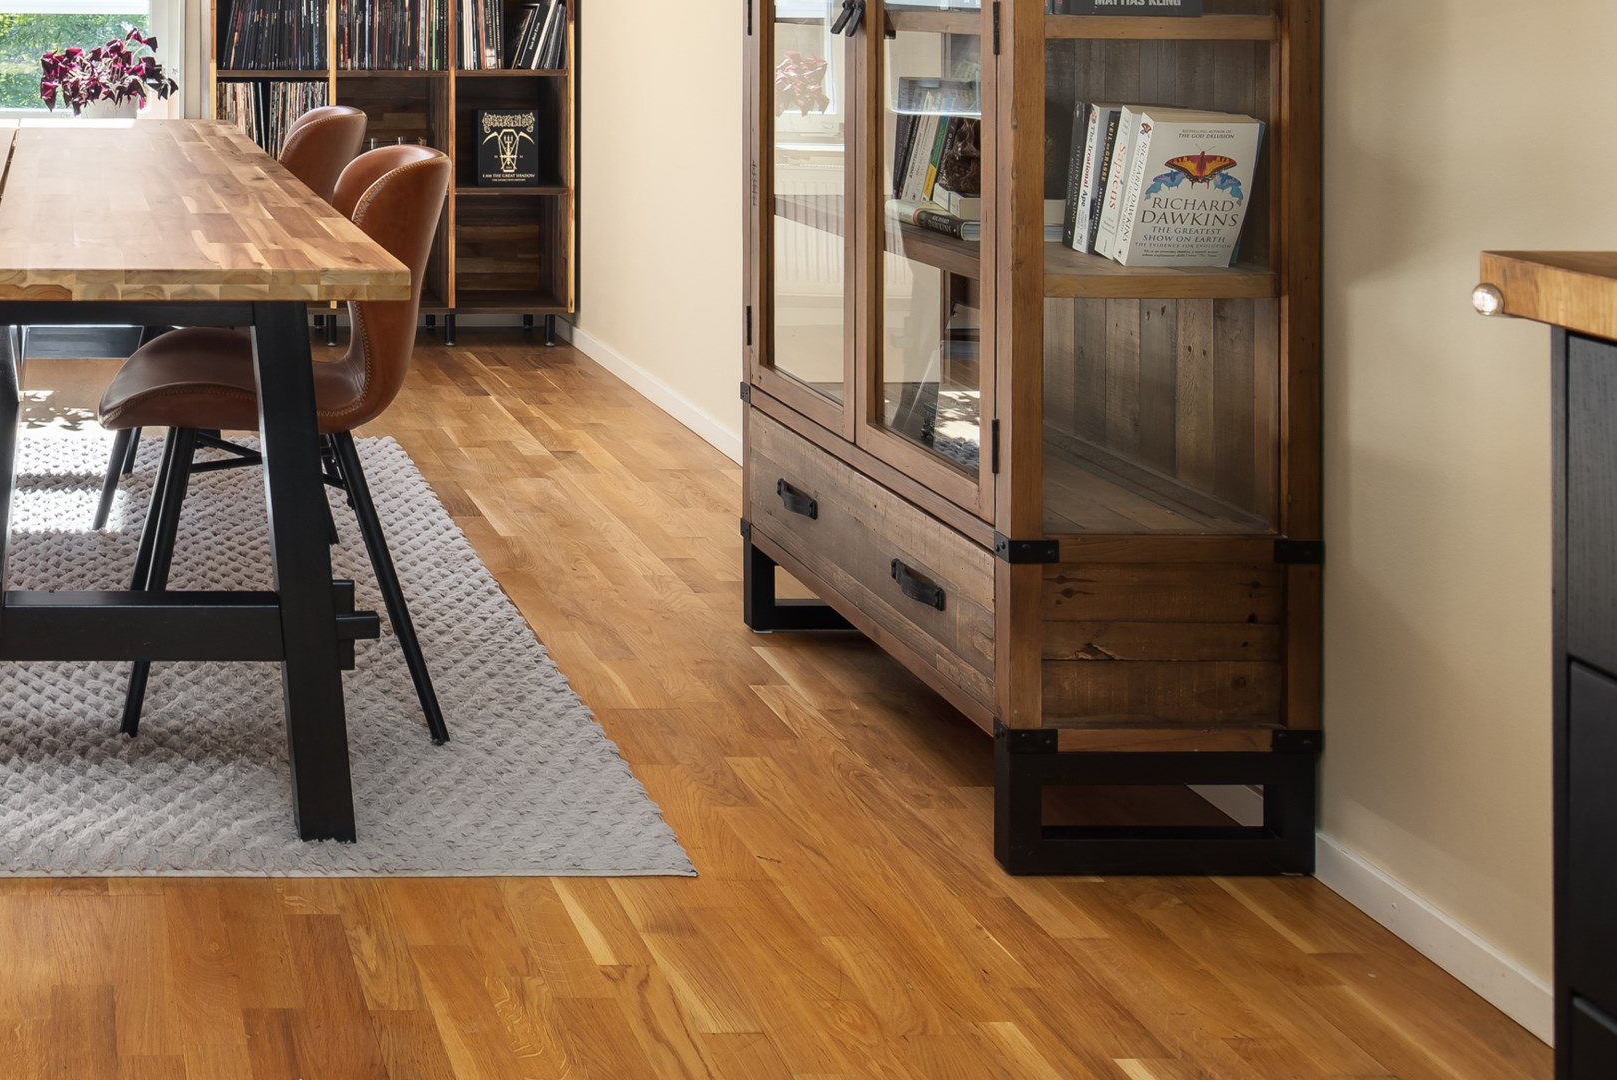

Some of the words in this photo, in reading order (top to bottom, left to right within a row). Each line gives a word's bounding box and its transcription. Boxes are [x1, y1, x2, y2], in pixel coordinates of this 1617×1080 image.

[1088, 124, 1096, 144] The
[1107, 121, 1115, 139] NEIL
[1083, 145, 1094, 189] Irrational
[1134, 142, 1148, 191] RICHARD
[1109, 142, 1127, 210] Sapiens
[1080, 189, 1088, 207] Ape
[1152, 197, 1234, 212] RICHARD
[1122, 192, 1138, 243] DAWKINS
[1141, 210, 1239, 227] DAWKINS
[1174, 227, 1223, 235] GREATEST
[1175, 235, 1192, 243] ON
